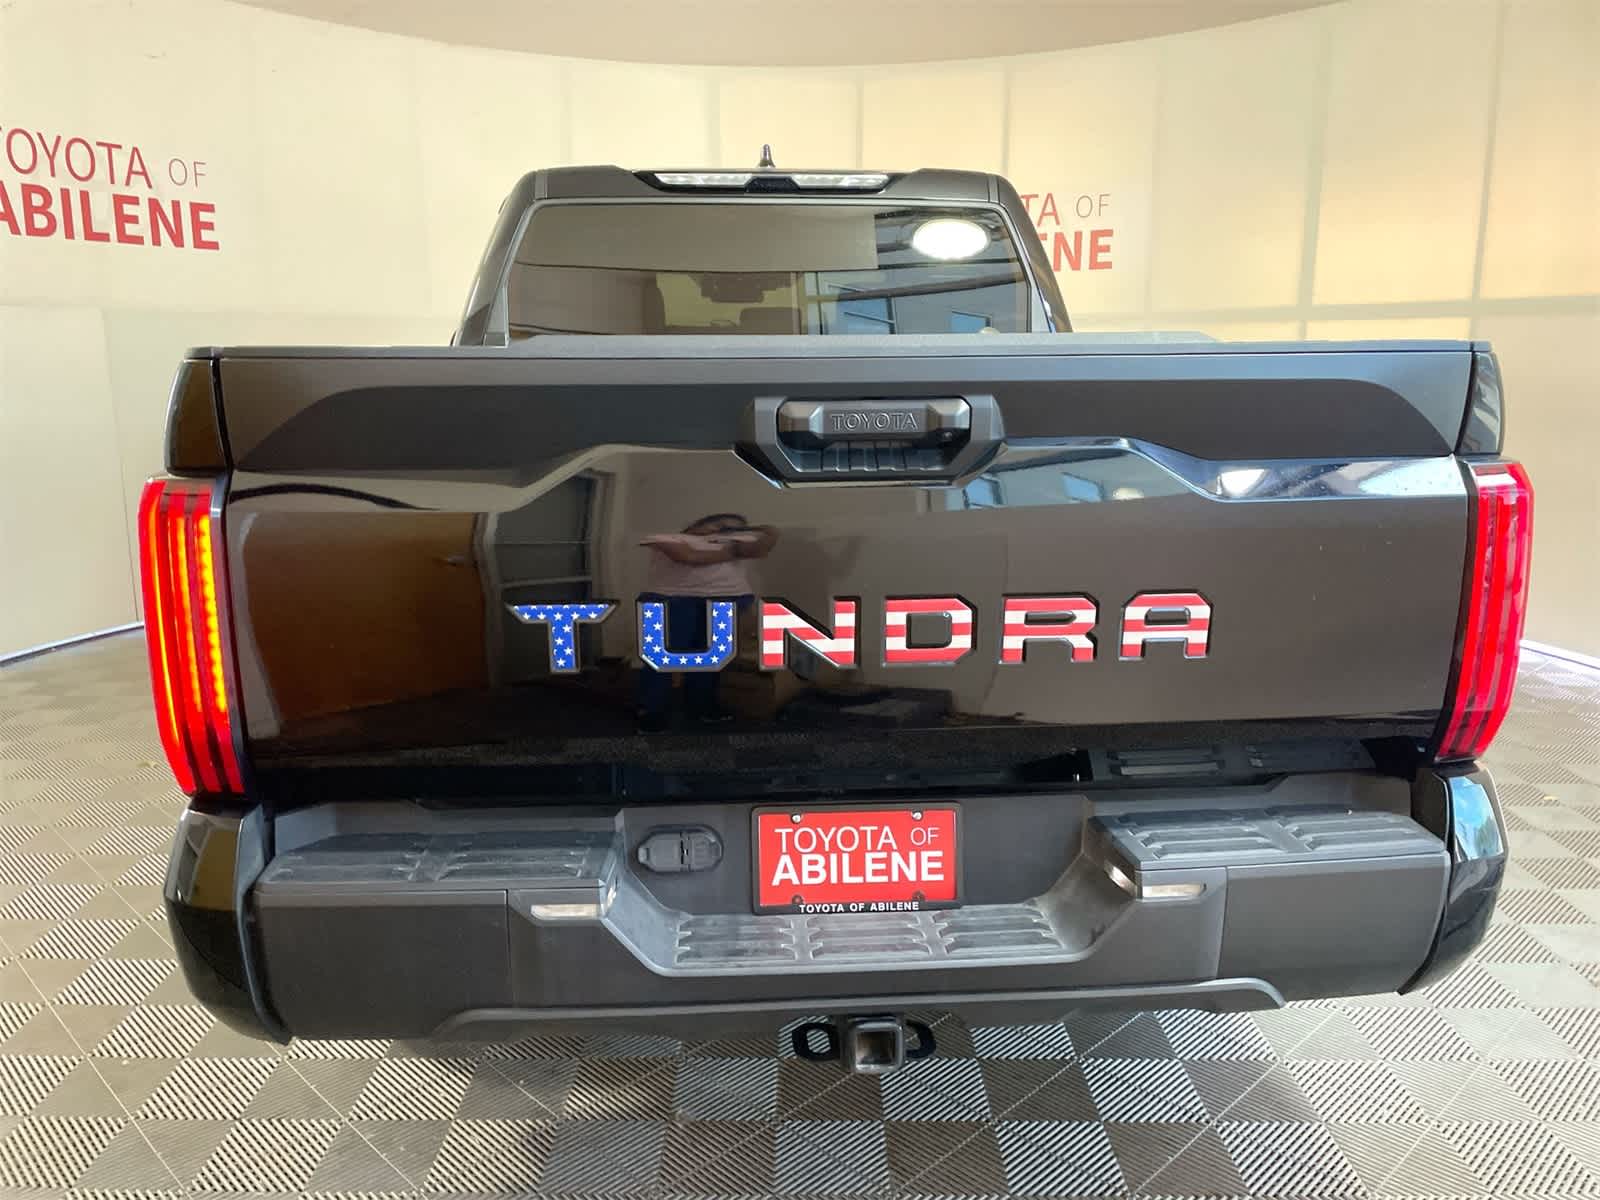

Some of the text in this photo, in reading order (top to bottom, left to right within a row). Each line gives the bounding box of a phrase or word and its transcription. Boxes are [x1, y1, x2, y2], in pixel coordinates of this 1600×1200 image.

[0, 126, 207, 189] OYOTA OF
[1020, 192, 1111, 227] TA OF
[831, 412, 920, 431] TOYOTA
[506, 590, 1214, 674] TUNDRA
[774, 825, 940, 854] TOYOTA OF
[771, 850, 945, 886] ABILENE
[799, 901, 920, 914] TOYOTA OF ABILENE
